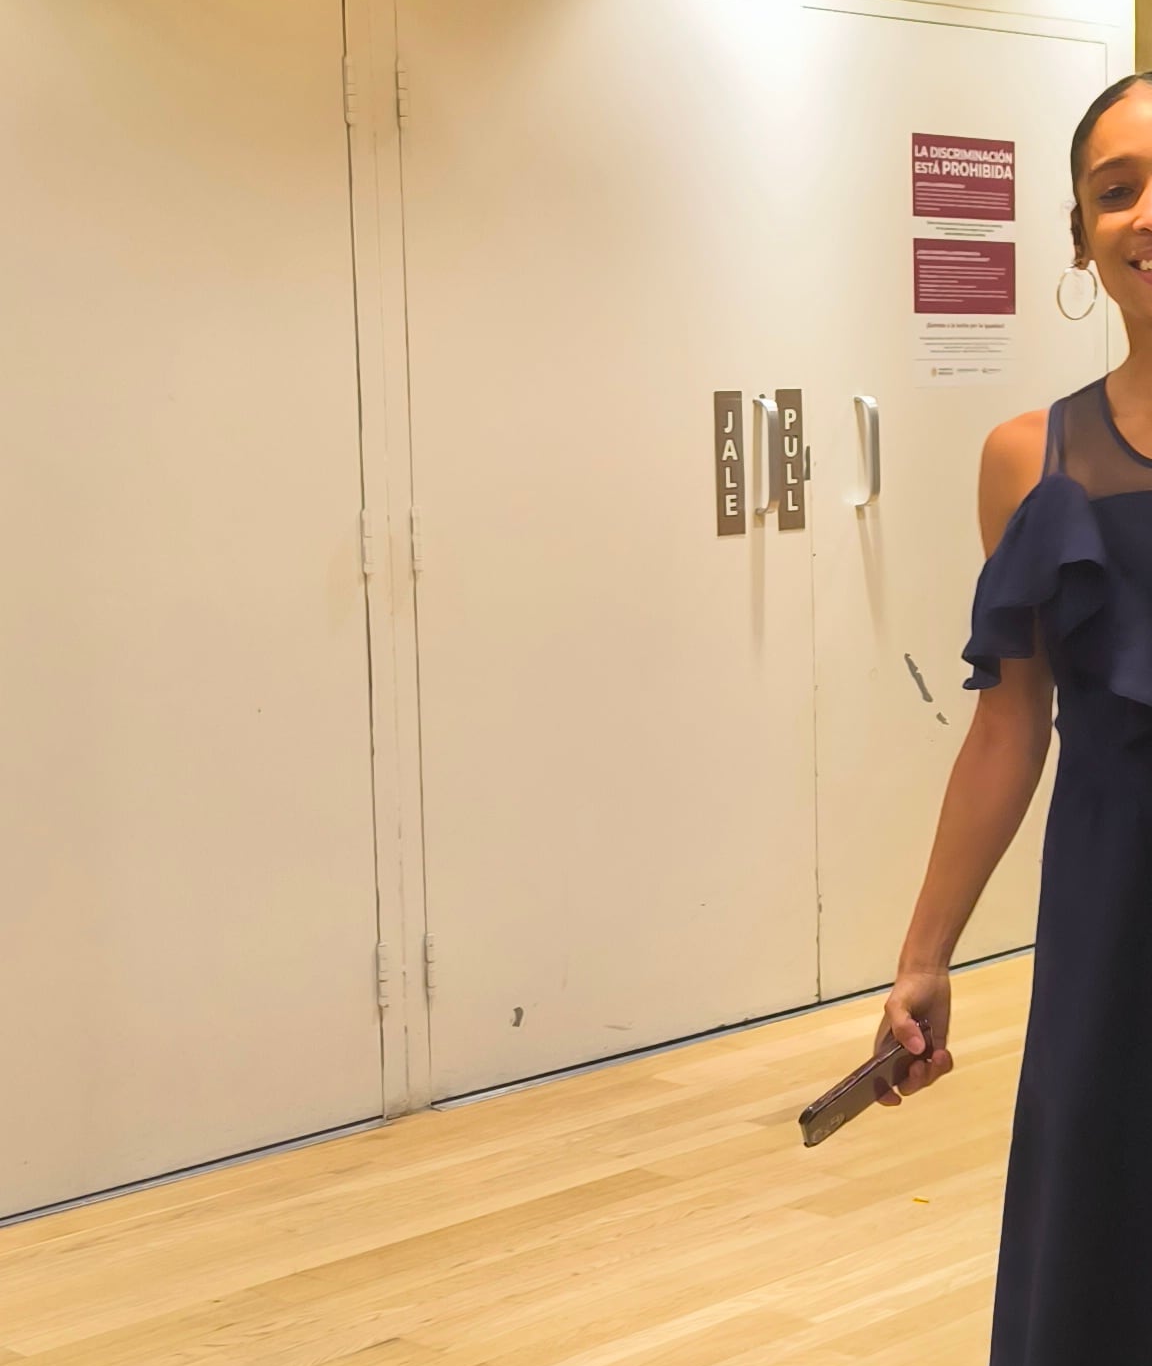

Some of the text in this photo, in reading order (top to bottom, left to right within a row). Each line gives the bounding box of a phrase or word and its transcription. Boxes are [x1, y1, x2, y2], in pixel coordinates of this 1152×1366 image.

[914, 144, 1013, 164] LA DISCRIMINACIÓN
[914, 160, 1013, 180] ESTÁ PROHIBIDA
[721, 411, 738, 516] JALE
[784, 408, 799, 512] PULL
